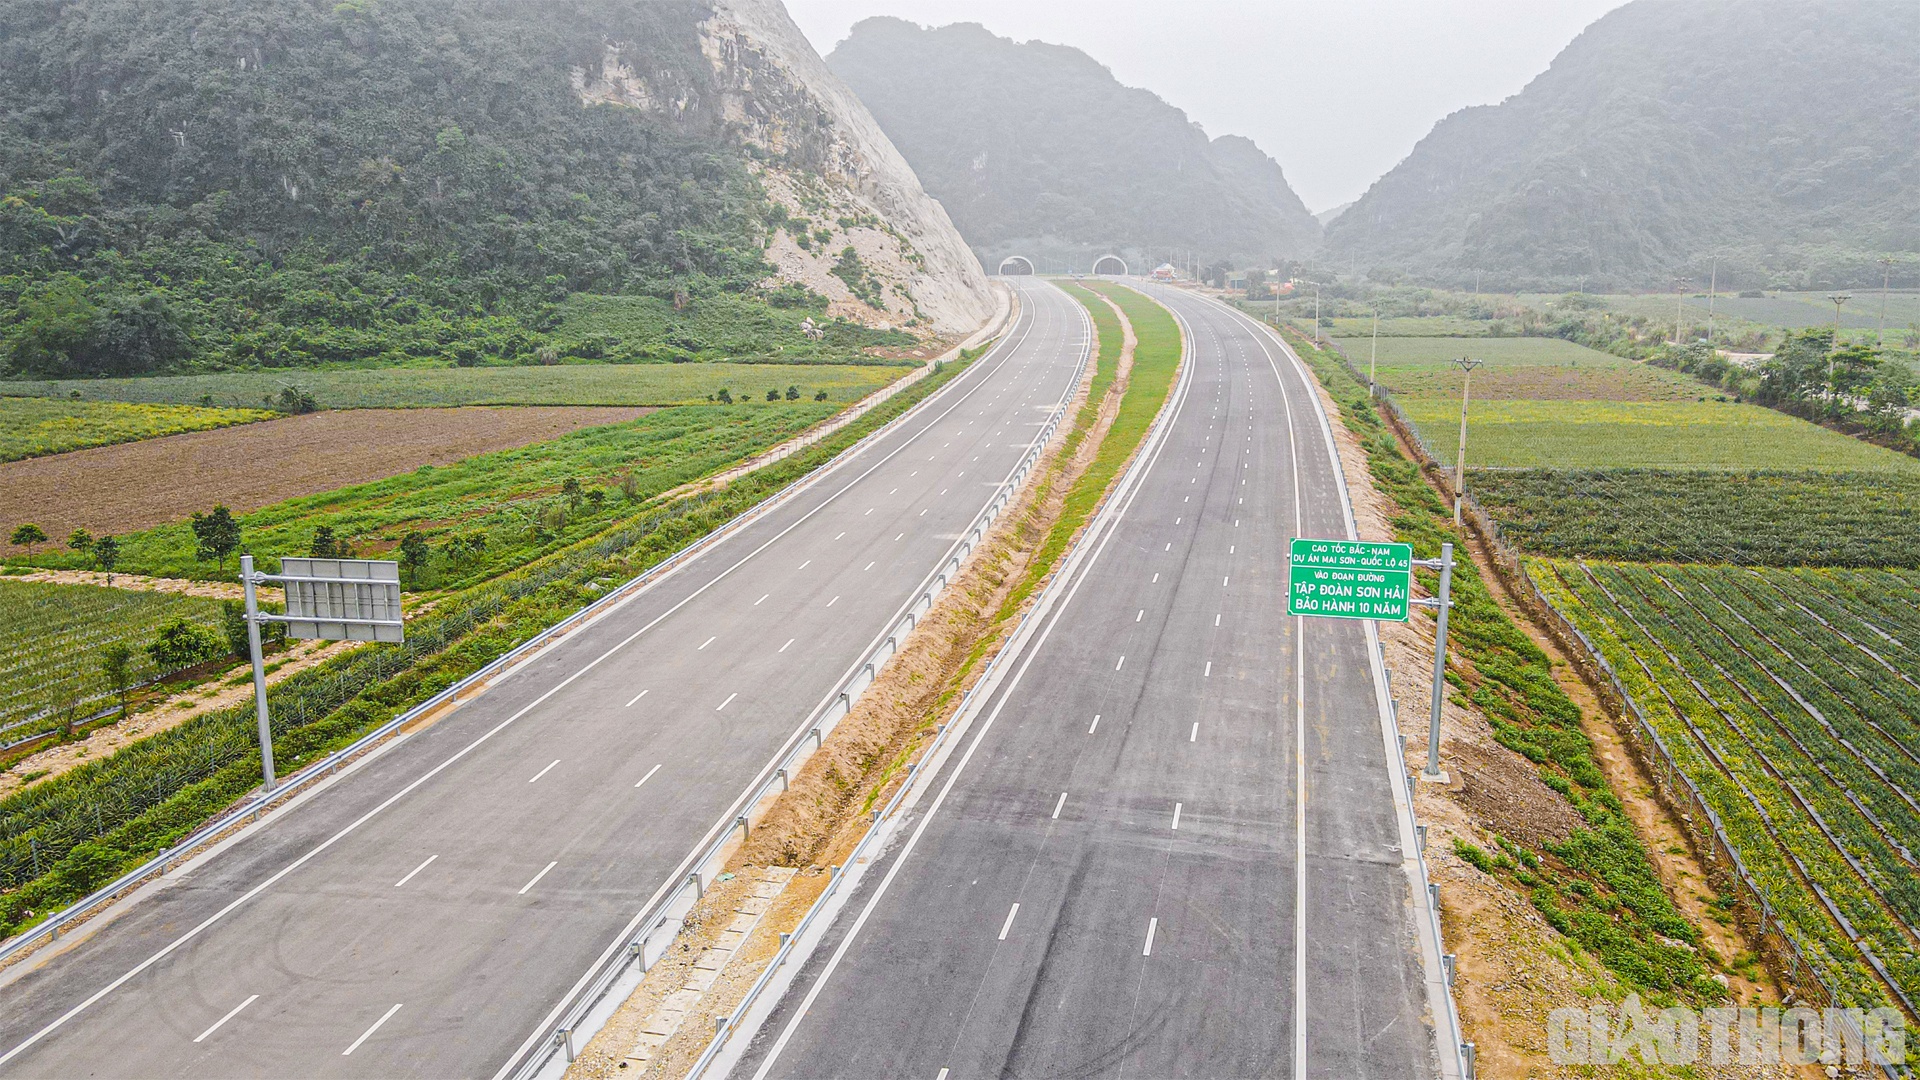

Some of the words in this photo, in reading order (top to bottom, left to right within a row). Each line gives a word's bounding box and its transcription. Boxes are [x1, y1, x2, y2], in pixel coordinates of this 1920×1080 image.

[1312, 544, 1328, 552] CAO
[1331, 542, 1346, 554] TỐC
[1294, 554, 1305, 563] DỰ
[1308, 554, 1319, 563] ÁN
[1322, 556, 1337, 564] MAI
[1385, 558, 1396, 567] LỘ
[1314, 570, 1328, 579] VÀO
[1332, 572, 1354, 581] ĐOẠN
[1358, 571, 1385, 582] ĐƯỜNG
[1294, 581, 1316, 596] TẬP
[1320, 581, 1352, 597] ĐOÀN
[1356, 587, 1380, 598] SƠN
[1384, 585, 1404, 599] HẢI
[1295, 596, 1319, 610] BẢO
[1322, 598, 1355, 612] HÀNH
[1359, 603, 1369, 613] 10
[1374, 602, 1400, 615] NĂM
